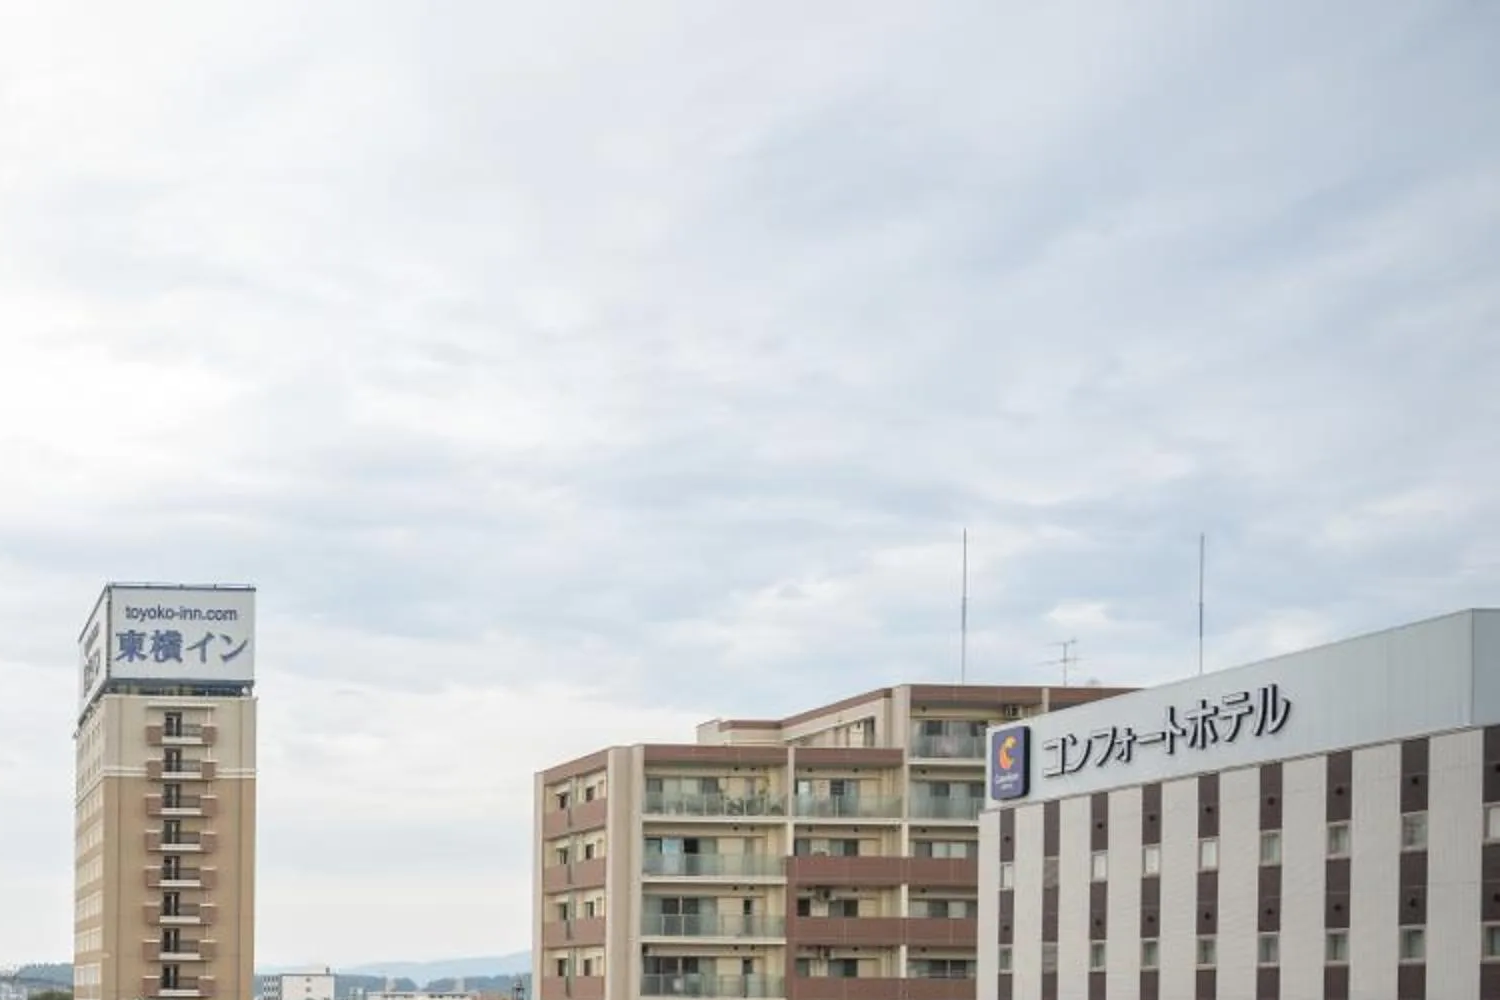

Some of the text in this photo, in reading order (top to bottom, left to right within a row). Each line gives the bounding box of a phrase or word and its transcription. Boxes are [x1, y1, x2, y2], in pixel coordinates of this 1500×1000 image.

[125, 604, 238, 623] toyoko-inn.com
[114, 629, 248, 664] 東横イン
[1043, 684, 1291, 780] コンフォートホテル
